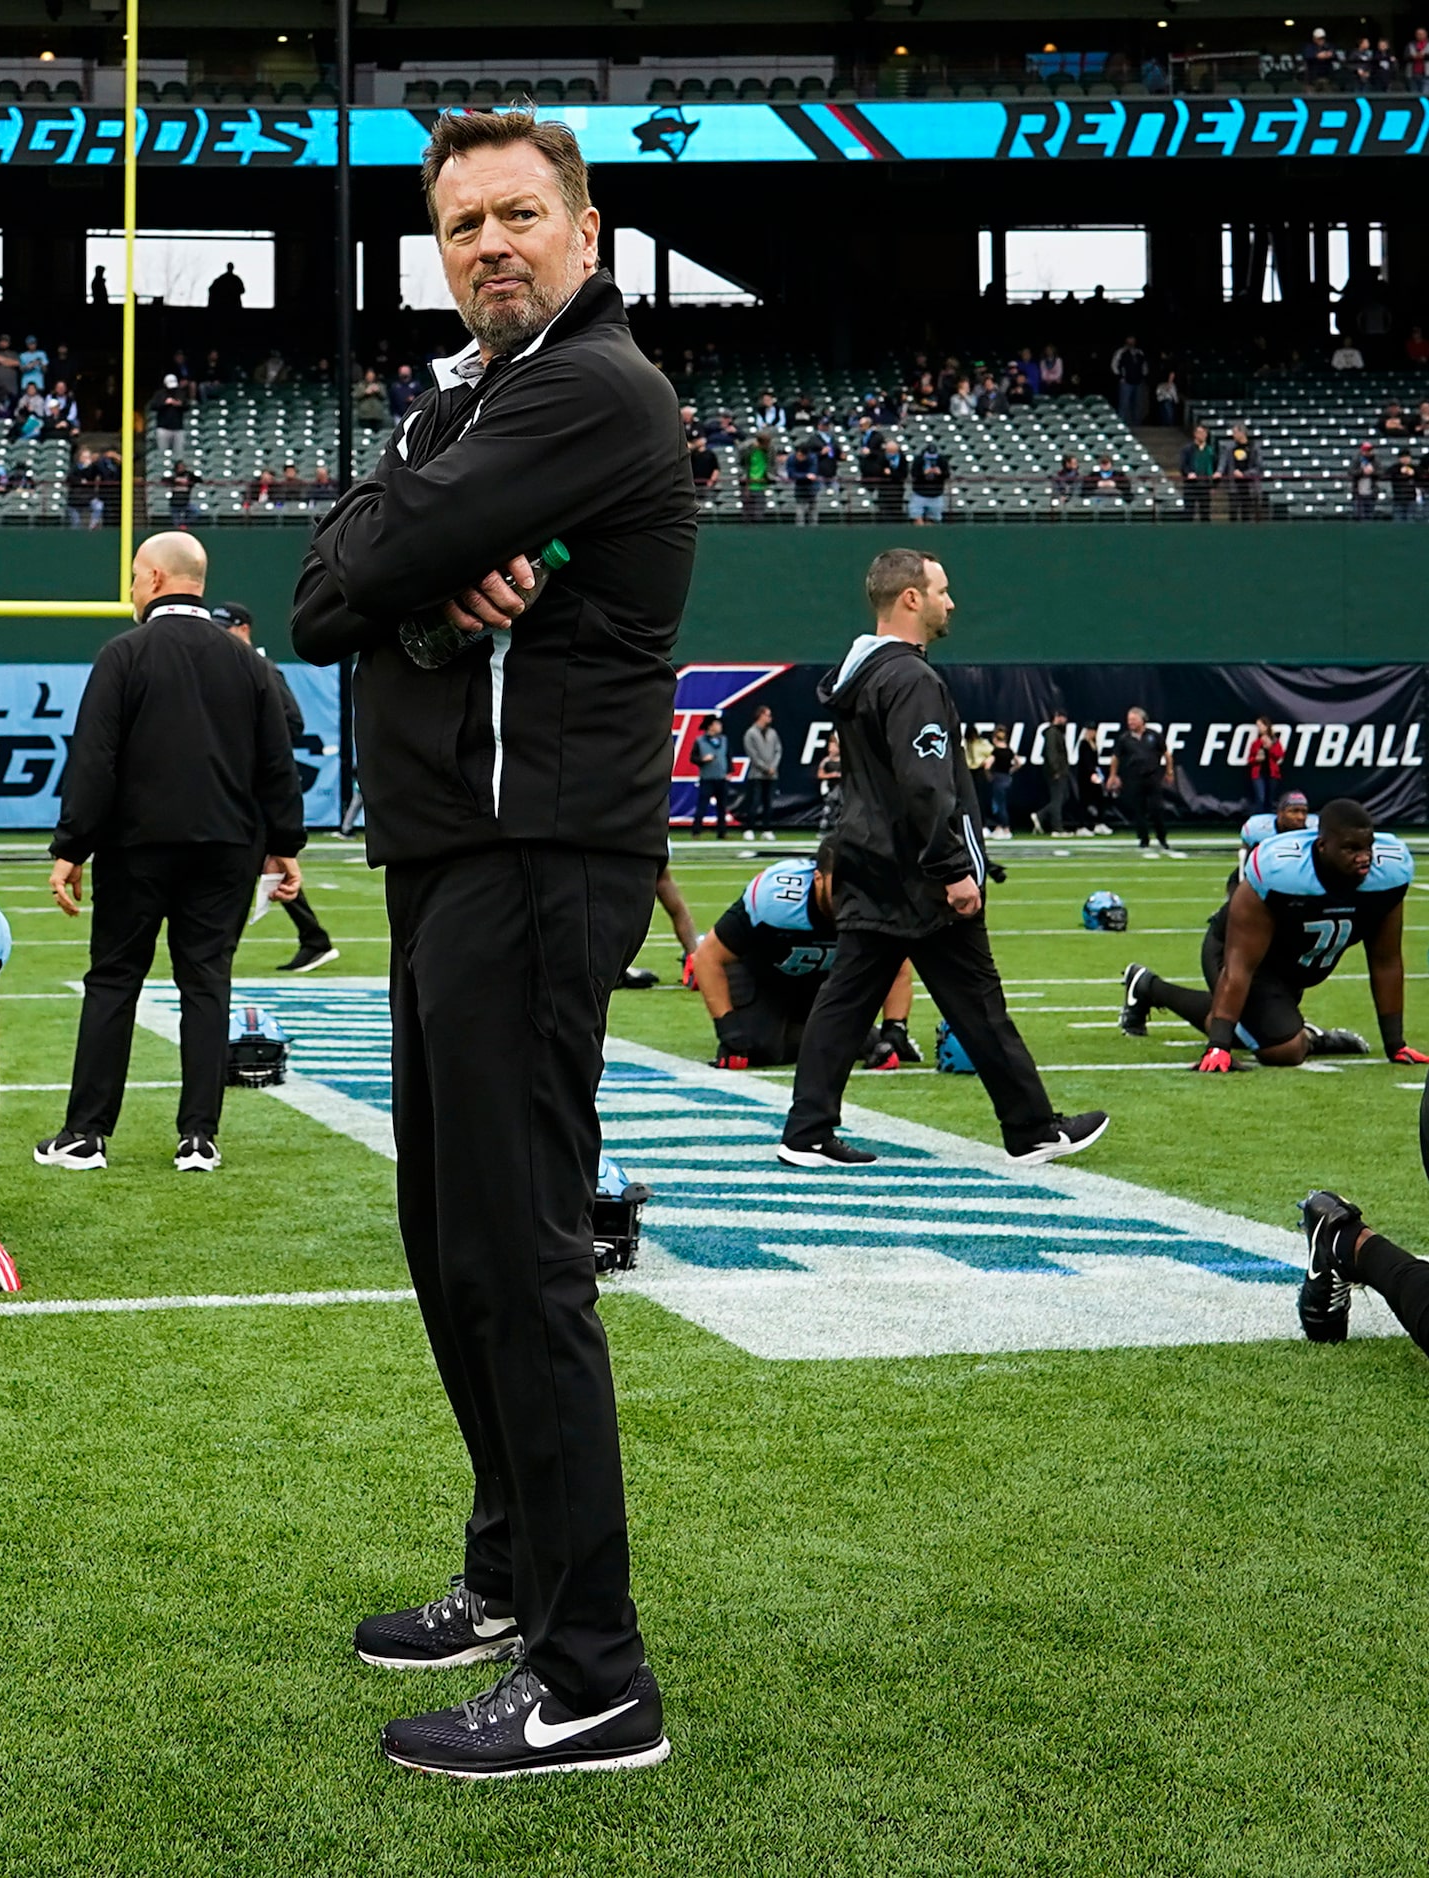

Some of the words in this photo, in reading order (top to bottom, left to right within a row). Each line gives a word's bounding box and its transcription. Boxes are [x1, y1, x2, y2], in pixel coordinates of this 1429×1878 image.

[1145, 722, 1192, 766] F
[775, 874, 803, 902] 64
[1298, 919, 1353, 968] 71
